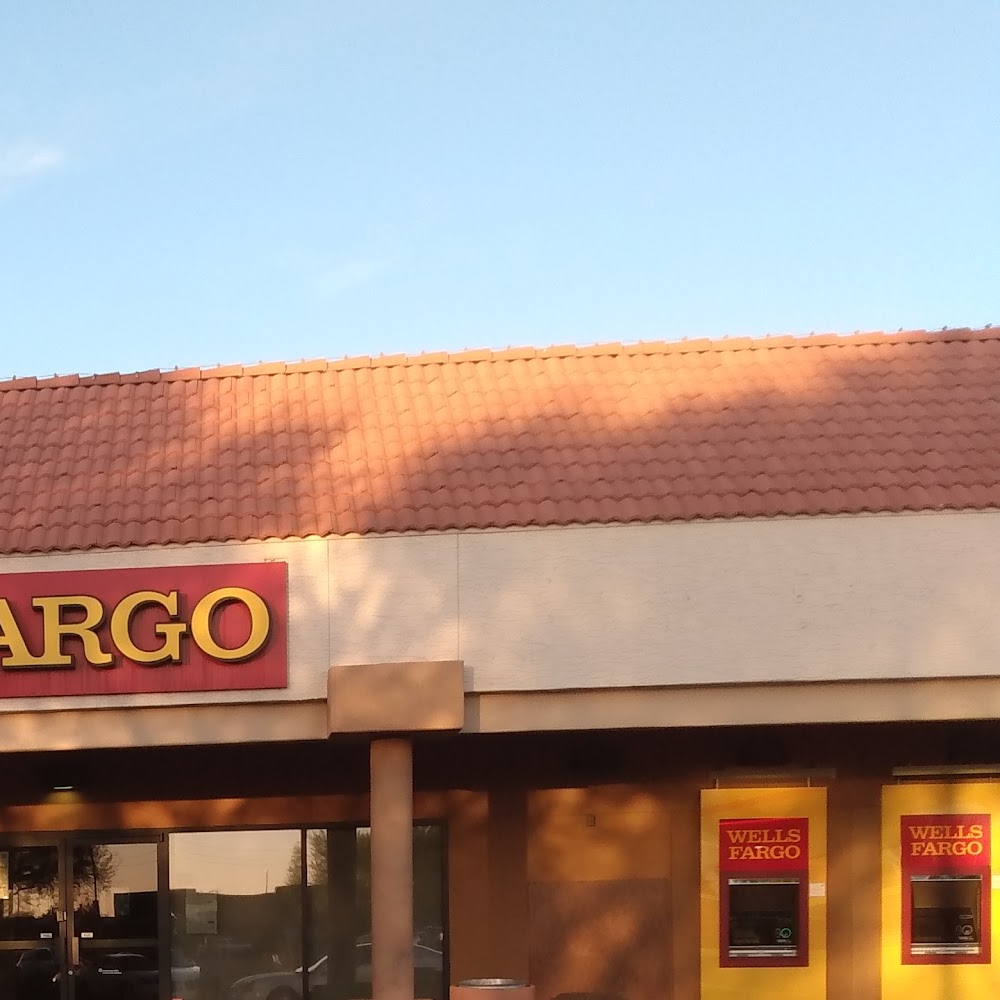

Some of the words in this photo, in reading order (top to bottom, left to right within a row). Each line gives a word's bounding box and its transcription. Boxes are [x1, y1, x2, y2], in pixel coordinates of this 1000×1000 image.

[726, 828, 801, 844] WELLS
[908, 825, 983, 840] WELLS
[728, 845, 801, 860] FARGO
[910, 841, 983, 856] FARGO
